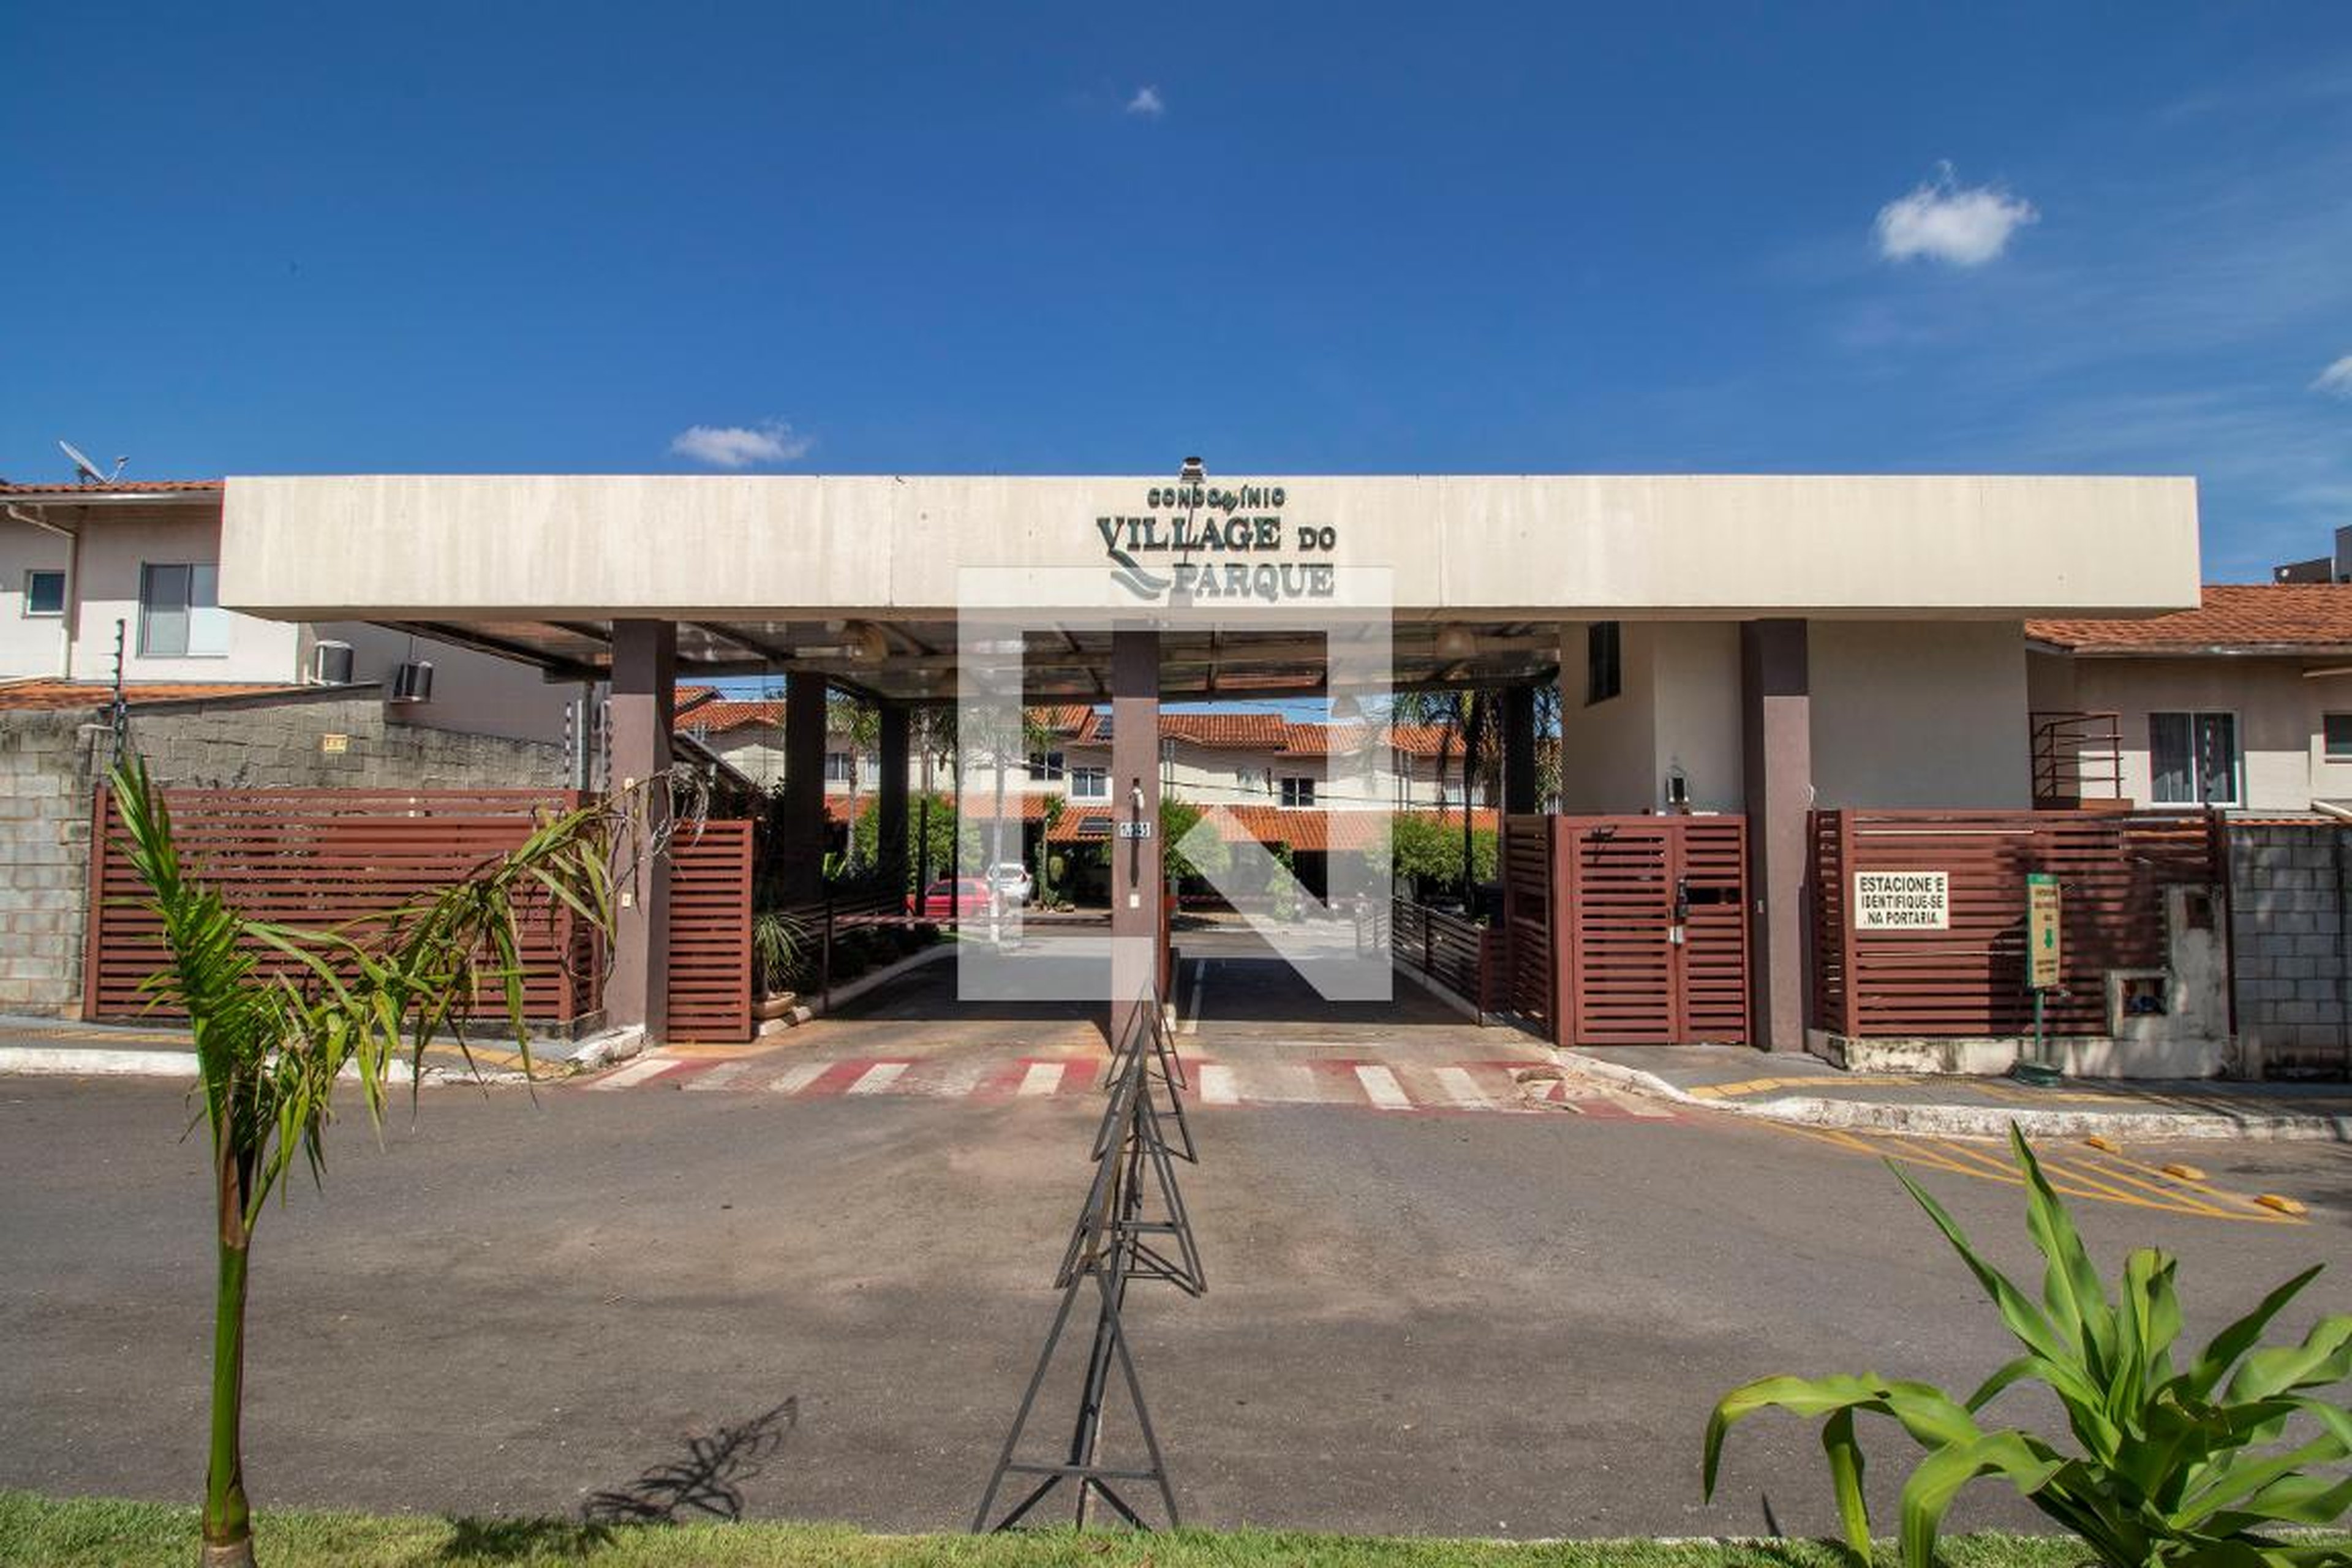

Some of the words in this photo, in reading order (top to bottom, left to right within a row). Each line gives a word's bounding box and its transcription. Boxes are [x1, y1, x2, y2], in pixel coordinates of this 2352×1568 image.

[1147, 485, 1285, 509] CONDOÍNIO
[1096, 516, 1281, 551] VILLAGE
[1298, 527, 1336, 550] DO
[1173, 564, 1334, 601] PARQUE
[1860, 877, 1931, 892] ESTACIONE
[1936, 877, 1943, 892] E
[1861, 895, 1943, 909] IDENTIFIQUE-SE
[1868, 911, 1883, 924] NA
[1887, 911, 1939, 924] PORTARIA
